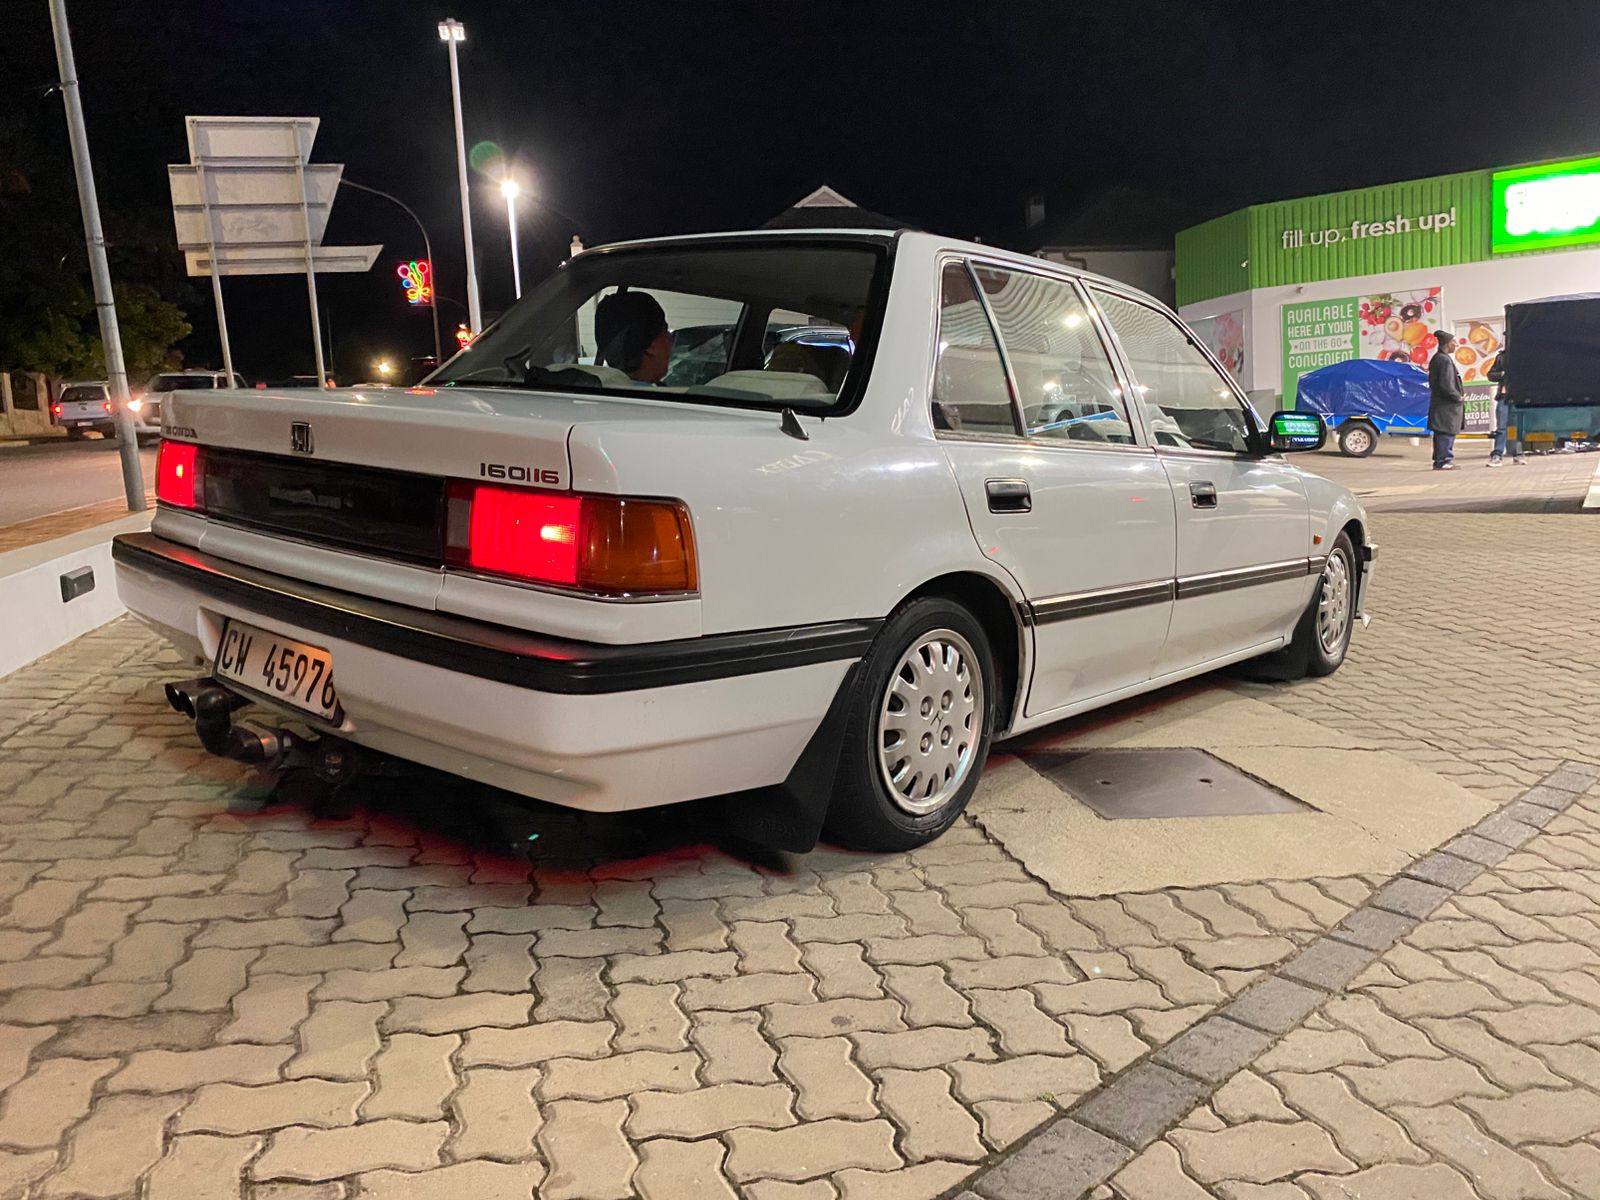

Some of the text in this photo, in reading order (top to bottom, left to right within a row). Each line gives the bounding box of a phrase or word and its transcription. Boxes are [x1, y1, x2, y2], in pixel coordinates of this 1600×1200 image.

[1282, 207, 1457, 249] fill up, fresh up!
[1287, 303, 1354, 325] AVAILABLE
[1287, 320, 1354, 338] HERE AT YOUR
[1300, 337, 1342, 351] ON THE GO
[1288, 350, 1354, 369] CONVENIENT
[165, 425, 198, 439] HONDA
[221, 629, 253, 676] CW
